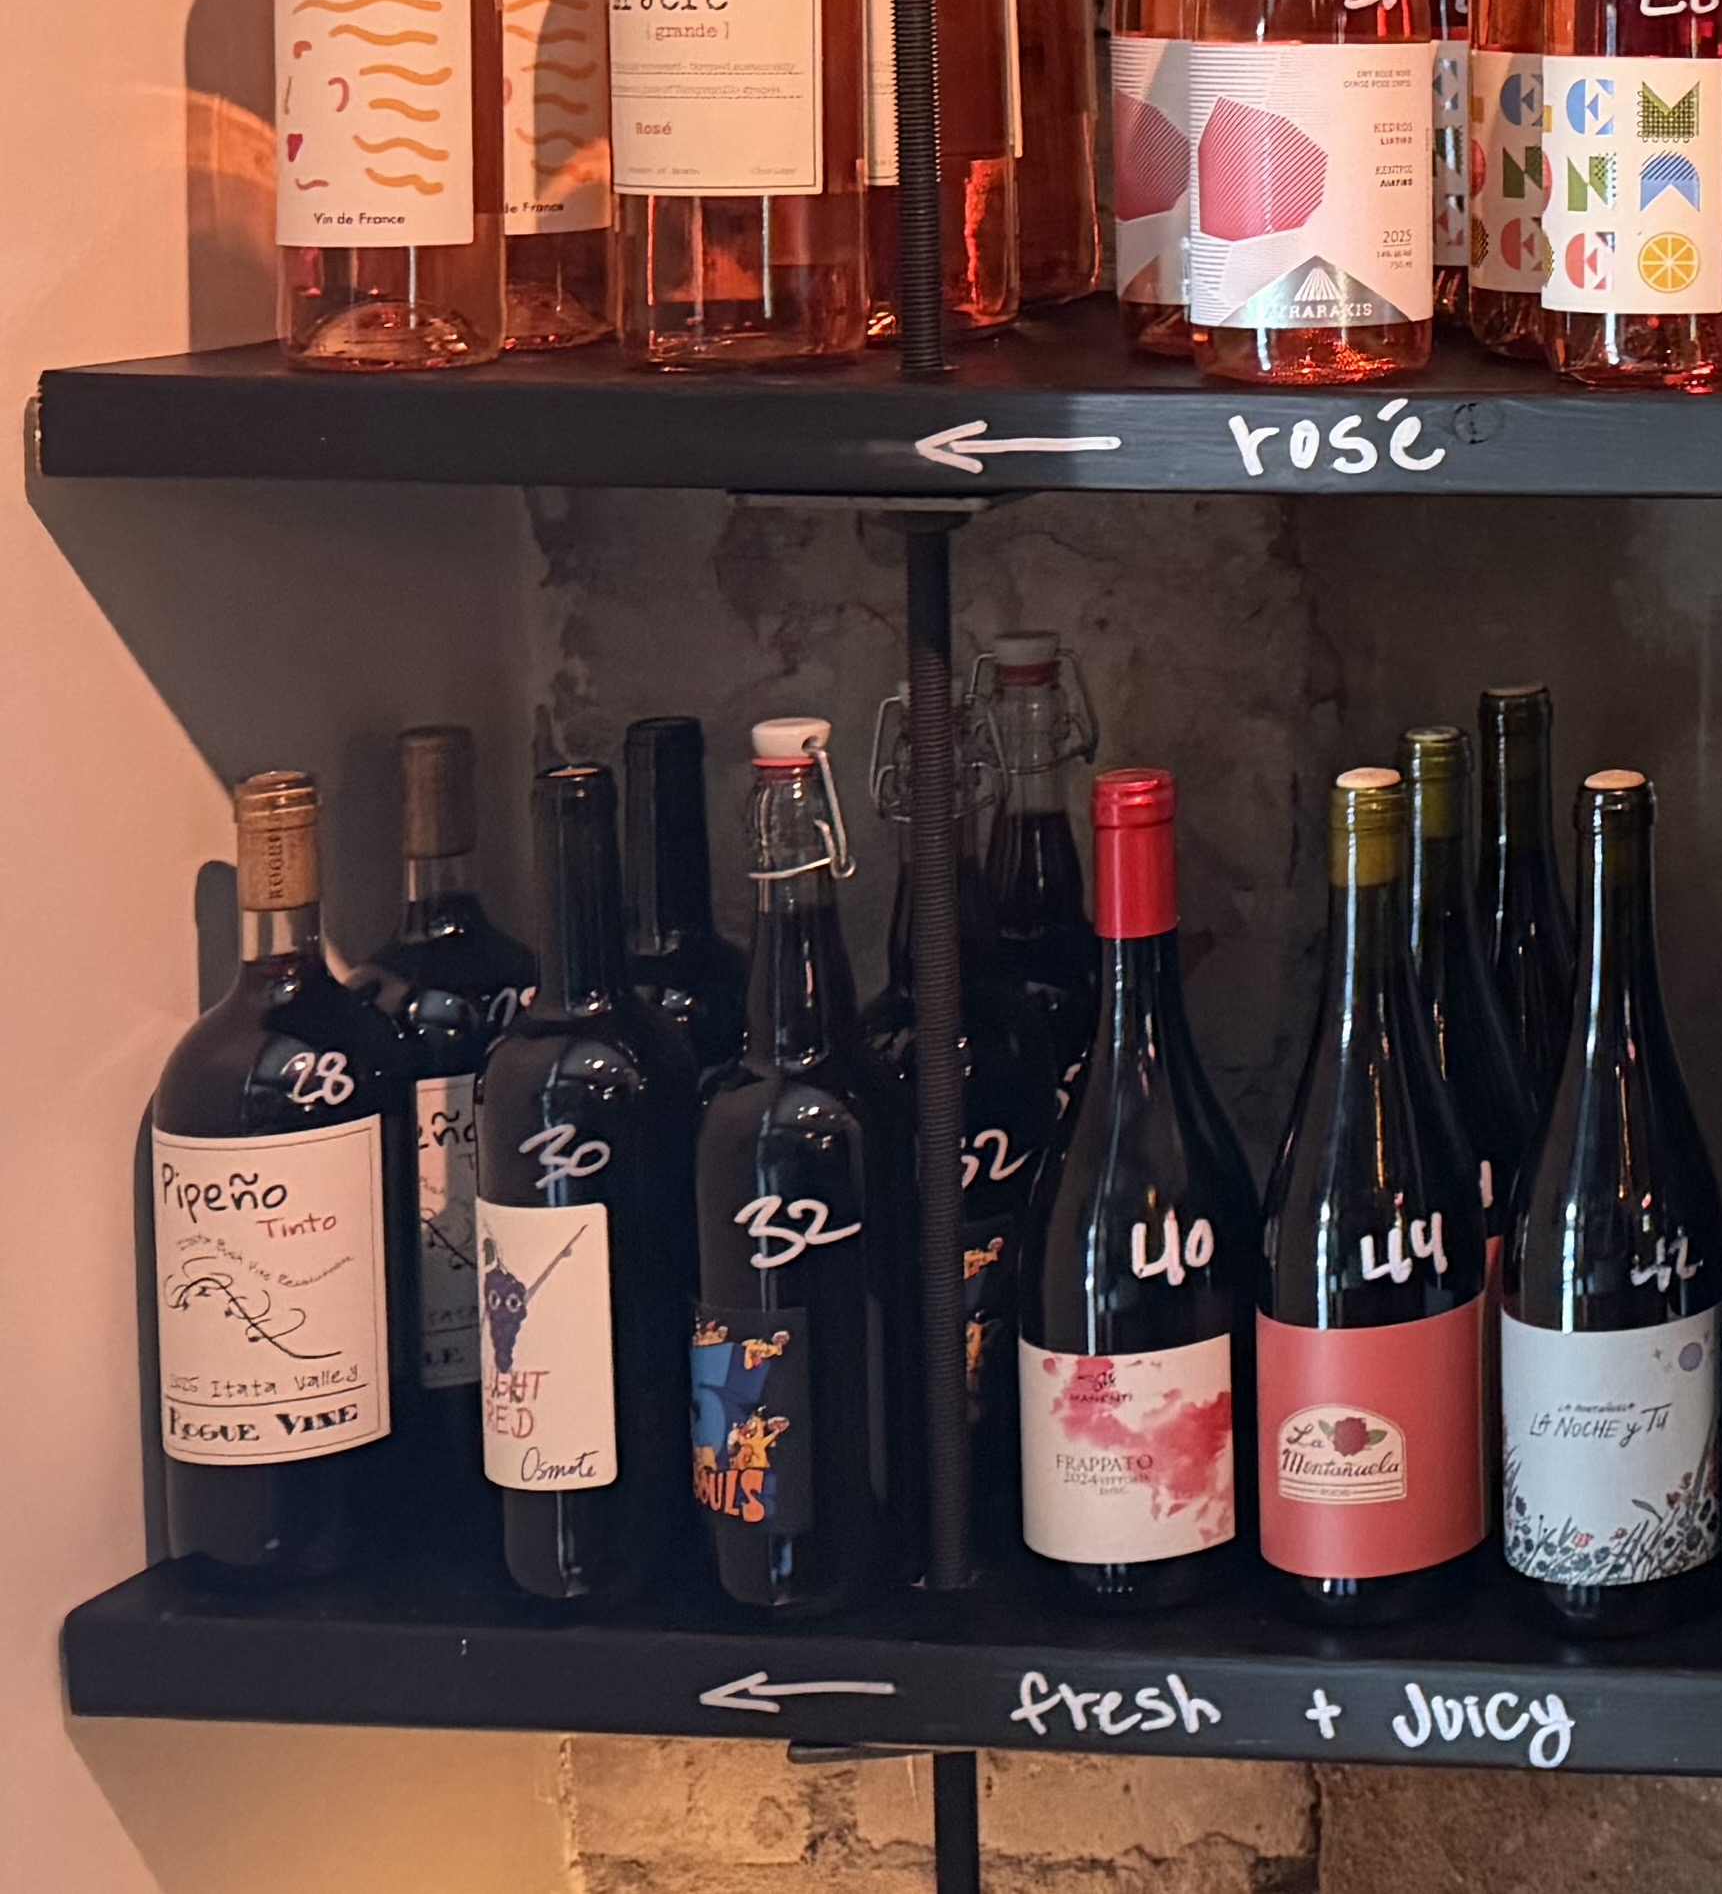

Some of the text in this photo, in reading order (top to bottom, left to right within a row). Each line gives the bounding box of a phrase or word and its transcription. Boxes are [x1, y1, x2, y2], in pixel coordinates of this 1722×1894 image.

[636, 121, 673, 136] Rosé
[313, 212, 406, 227] Vin de France
[522, 201, 565, 214] France
[1229, 399, 1447, 477] rosé
[280, 1051, 355, 1107] 28
[518, 1123, 611, 1190] 30
[161, 1161, 288, 1224] Pipeño
[257, 1213, 337, 1241] Tinto
[733, 1194, 863, 1269] 32
[1131, 1209, 1215, 1286] 40
[1360, 1212, 1449, 1285] 44
[210, 1364, 359, 1399] Itata Valley
[168, 1403, 359, 1442] ROGUE VINE
[1285, 1421, 1326, 1450] La
[1529, 1413, 1621, 1440] LA NOCHE
[519, 1446, 600, 1482] Osmote
[1055, 1453, 1154, 1473] FRAPPATO
[1062, 1473, 1098, 1486] 2024
[1280, 1448, 1402, 1477] Montañuela
[1012, 1672, 1576, 1769] fresh + Juicy
